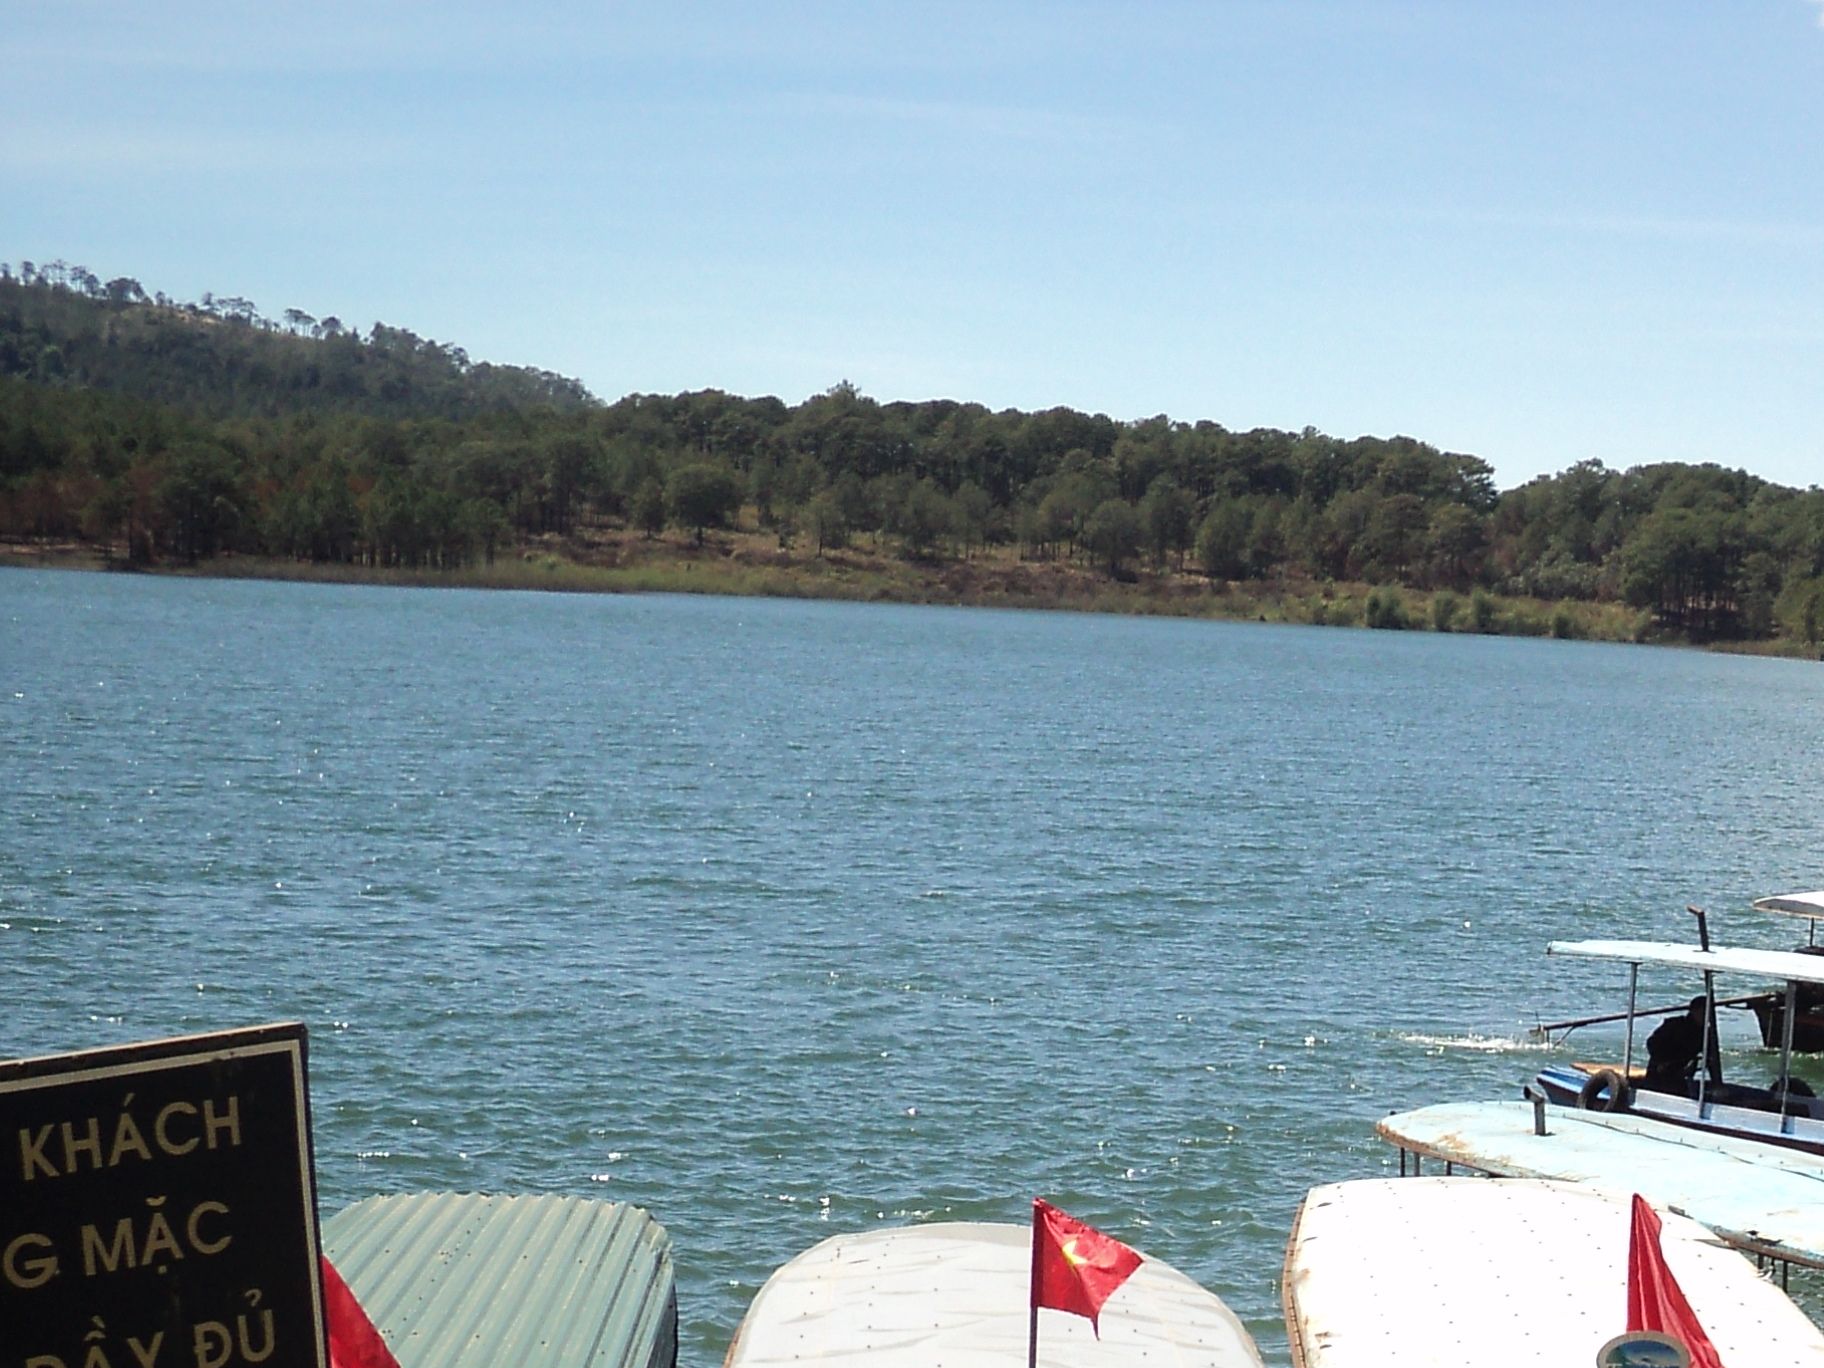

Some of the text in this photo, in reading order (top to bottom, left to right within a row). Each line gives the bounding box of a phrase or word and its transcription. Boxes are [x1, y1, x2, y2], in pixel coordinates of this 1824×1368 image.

[20, 1094, 240, 1180] KHÁCH
[4, 1196, 231, 1288] G MẶC
